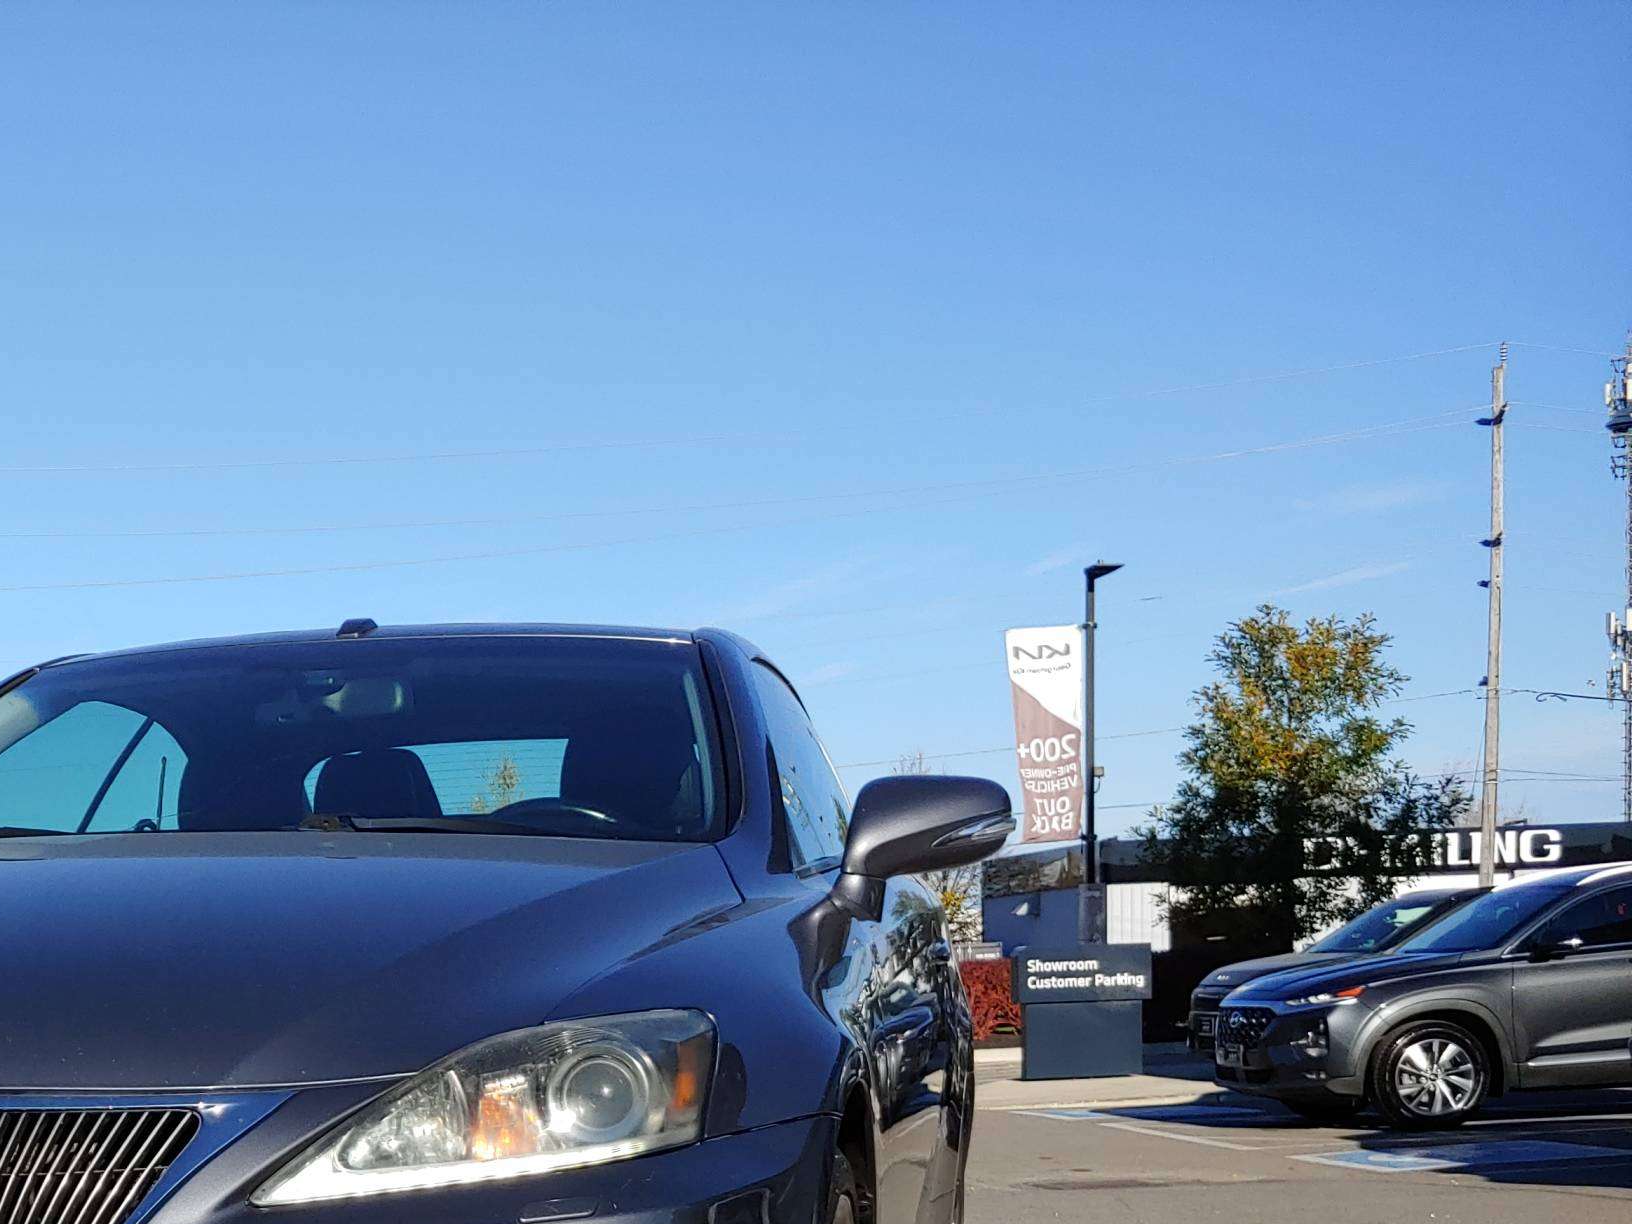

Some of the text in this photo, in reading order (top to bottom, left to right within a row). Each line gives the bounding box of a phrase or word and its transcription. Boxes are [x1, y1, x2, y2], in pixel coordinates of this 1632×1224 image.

[1027, 959, 1098, 973] Showroom
[1027, 973, 1145, 989] Customer Parking
